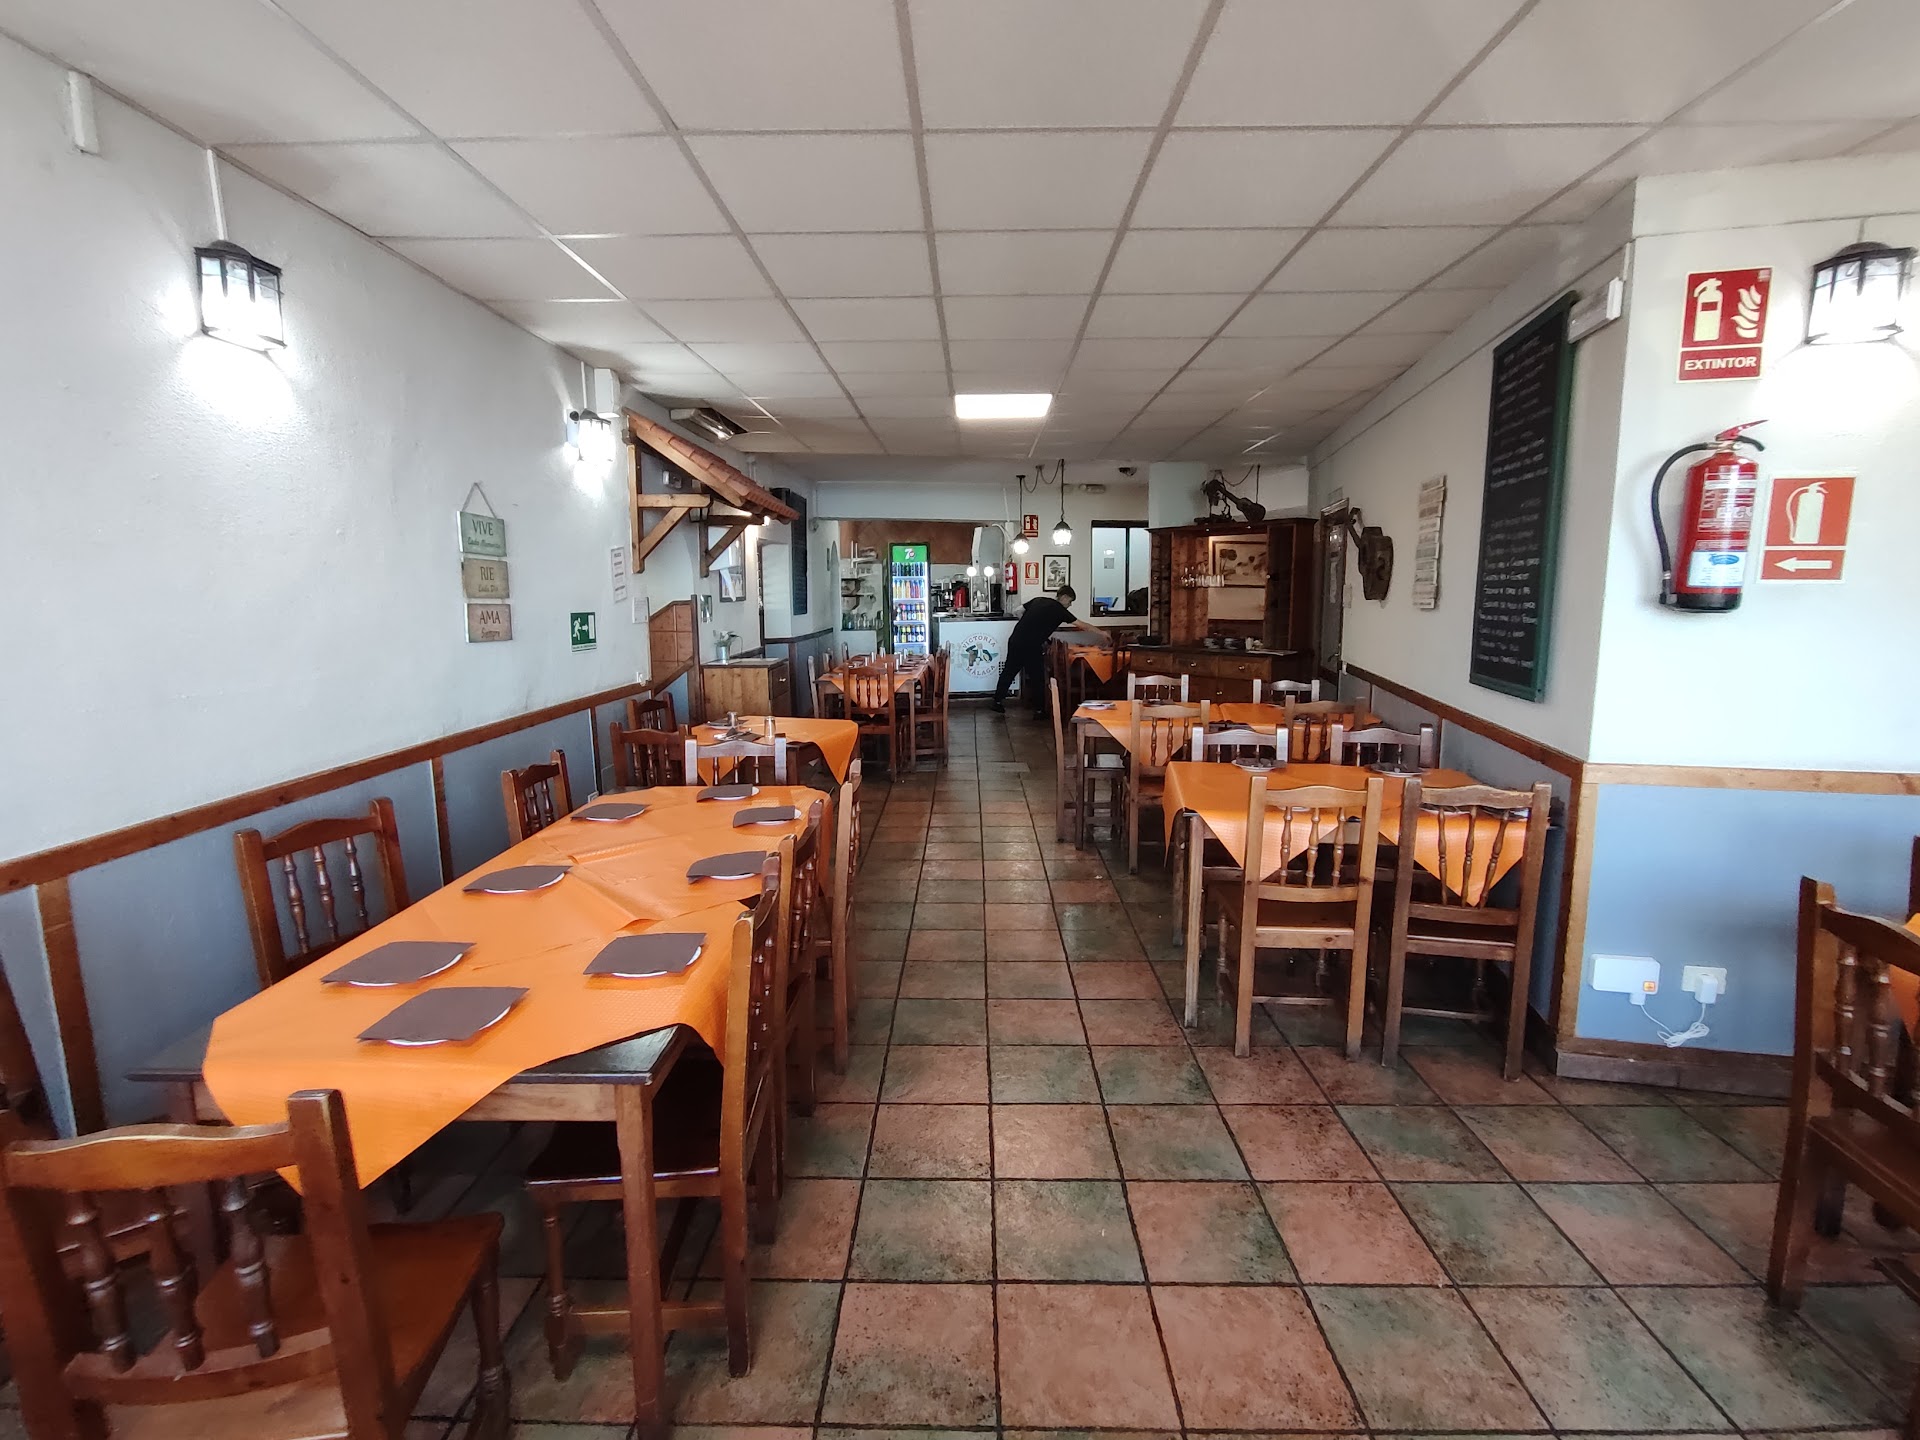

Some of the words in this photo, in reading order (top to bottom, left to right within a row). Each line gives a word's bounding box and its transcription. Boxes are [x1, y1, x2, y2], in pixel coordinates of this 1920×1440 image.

[1684, 355, 1757, 371] EXTINTOR
[472, 519, 494, 536] VIVE
[480, 566, 495, 581] RIE
[479, 610, 501, 625] AMA
[962, 635, 996, 649] VICTORIA
